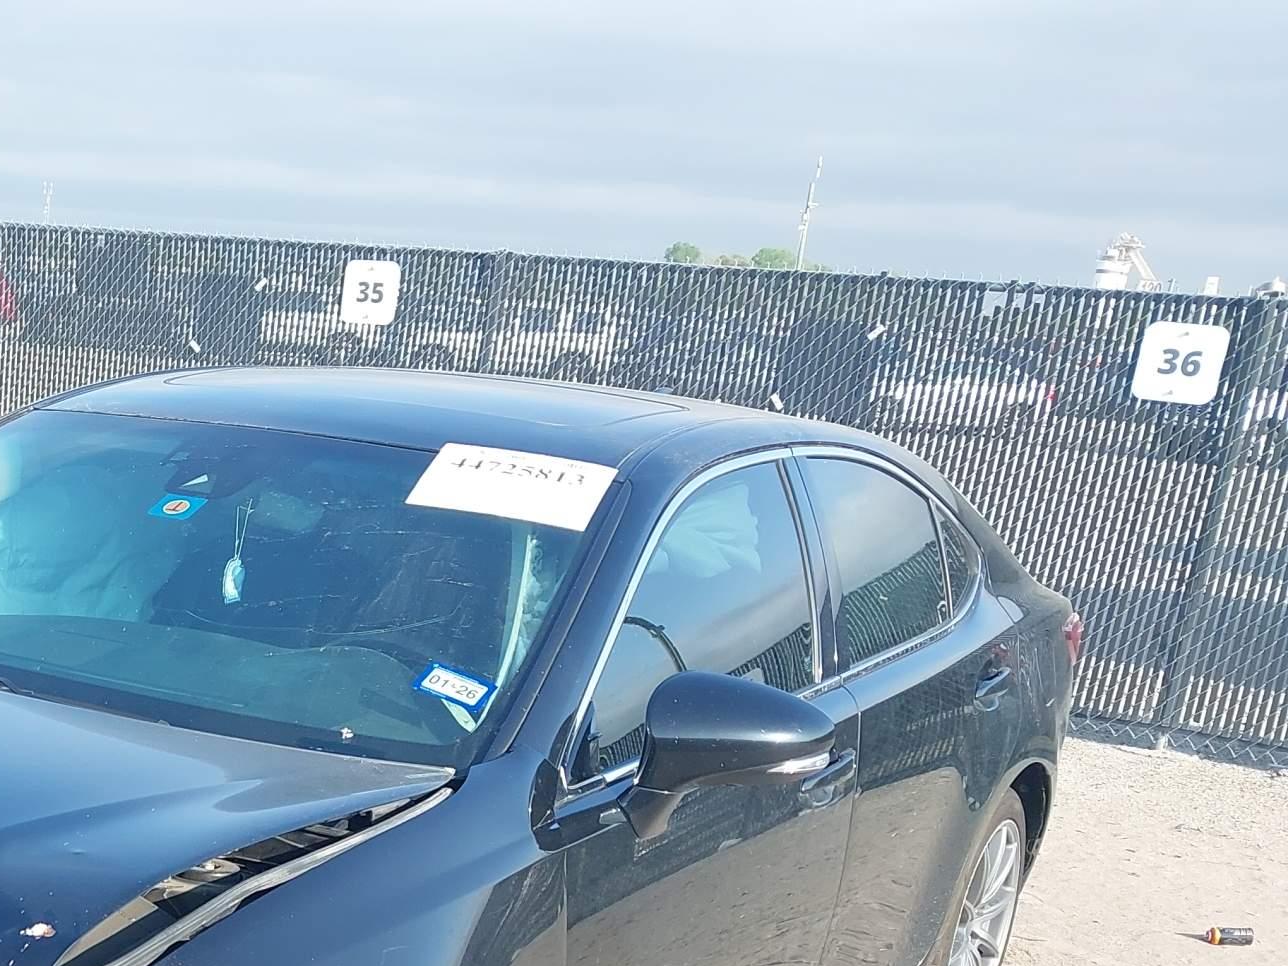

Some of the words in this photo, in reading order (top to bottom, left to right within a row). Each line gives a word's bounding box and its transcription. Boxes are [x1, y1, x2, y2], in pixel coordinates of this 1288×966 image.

[356, 281, 384, 304] 35
[1156, 348, 1204, 378] 36
[450, 457, 585, 486] 44725813
